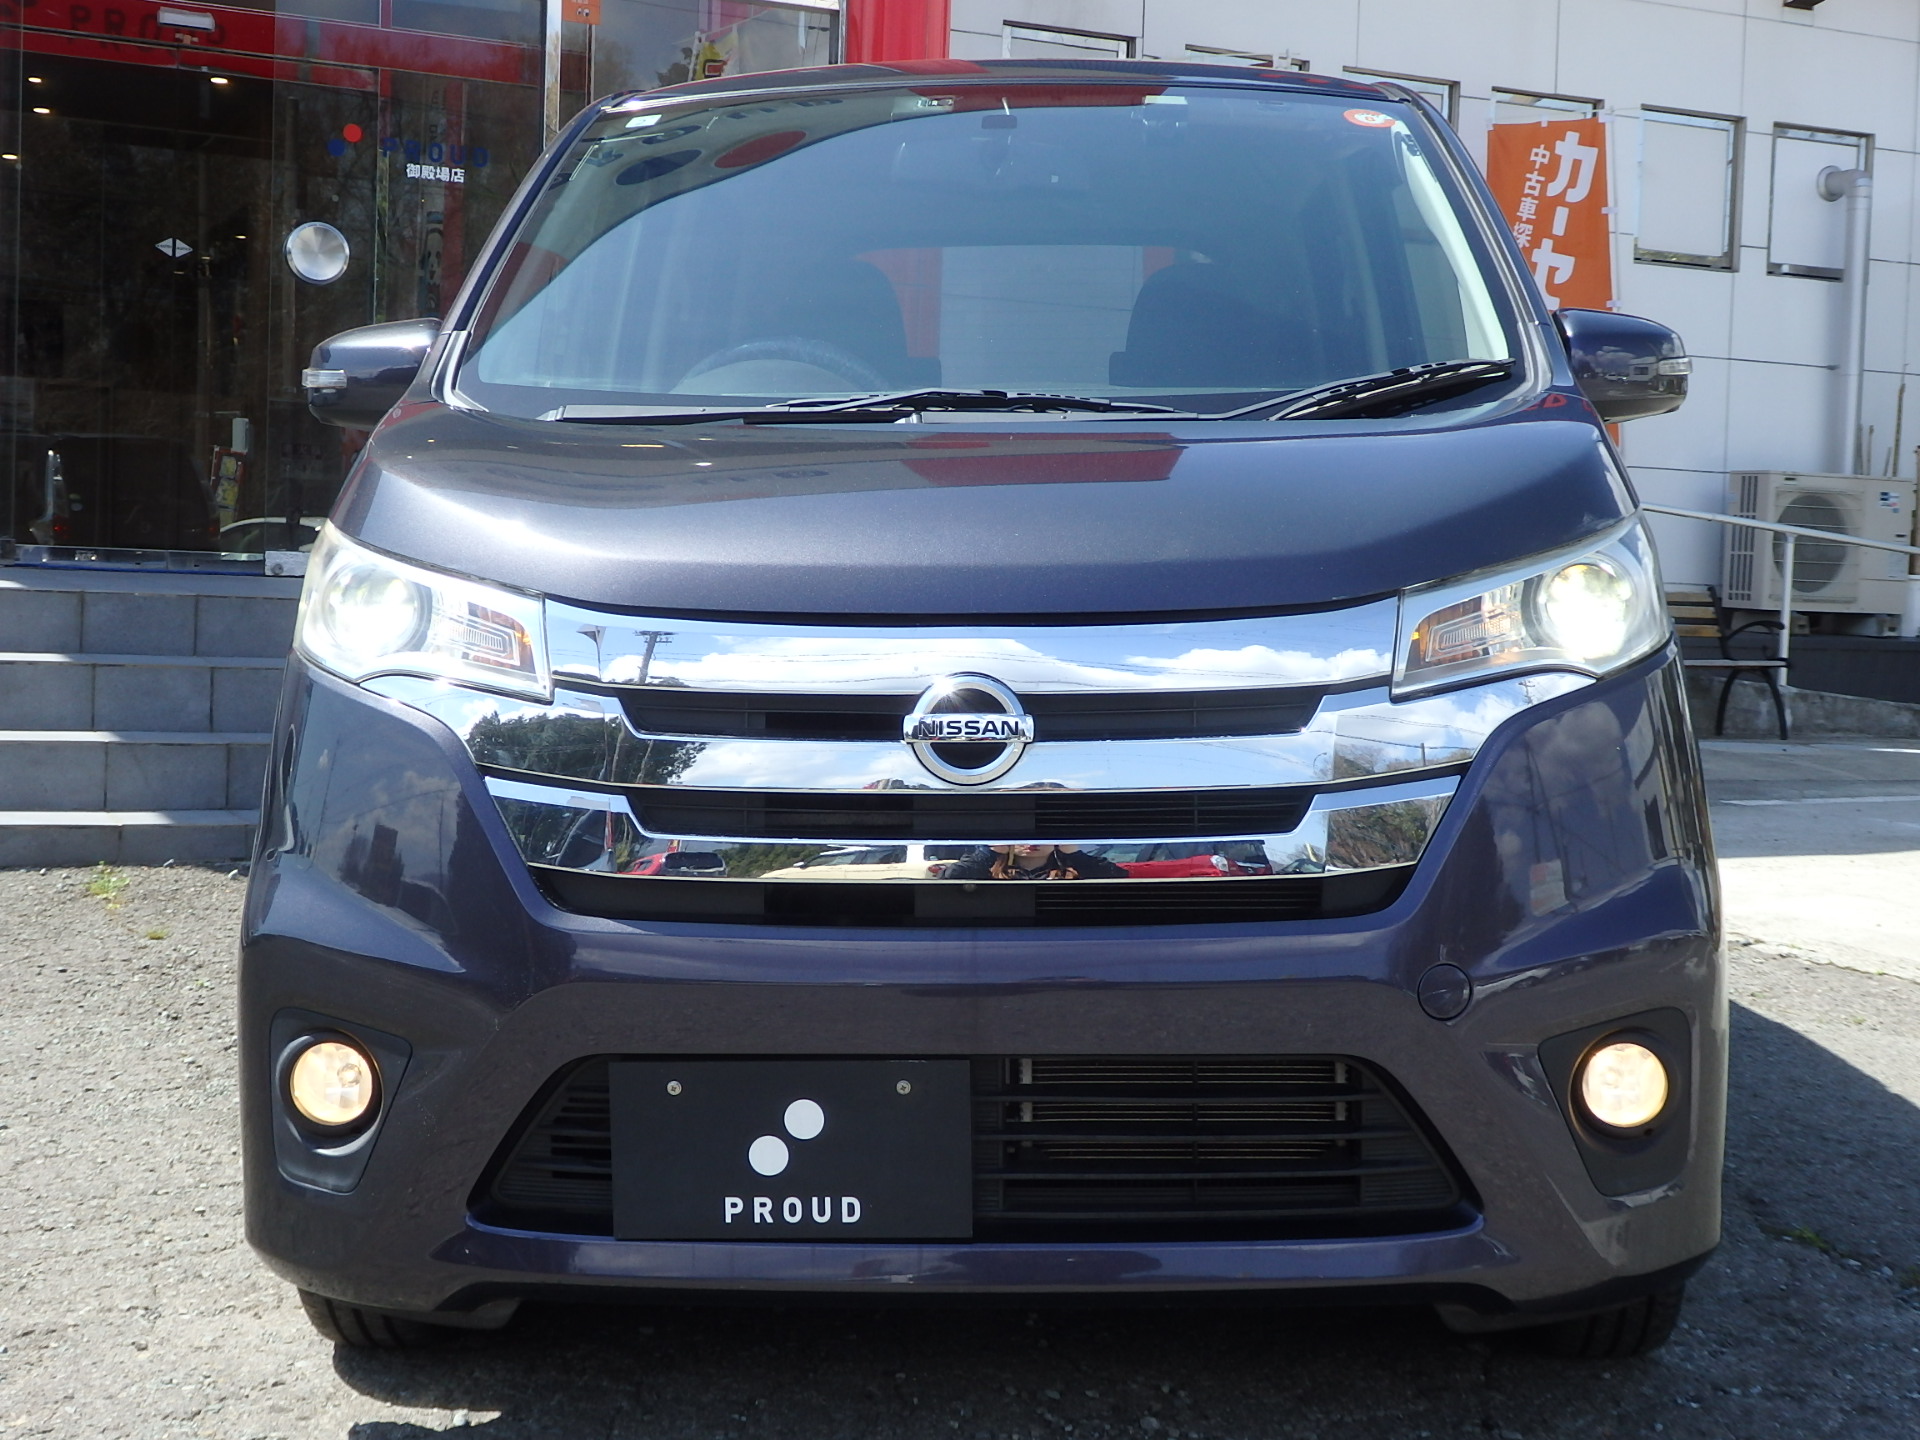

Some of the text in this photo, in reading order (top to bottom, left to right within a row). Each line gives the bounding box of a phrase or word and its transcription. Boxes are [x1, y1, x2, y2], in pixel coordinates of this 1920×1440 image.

[382, 136, 489, 169] PROUD
[406, 163, 466, 183] 御殿場店
[918, 720, 1020, 736] NISSAN
[724, 1196, 862, 1224] PROUD
